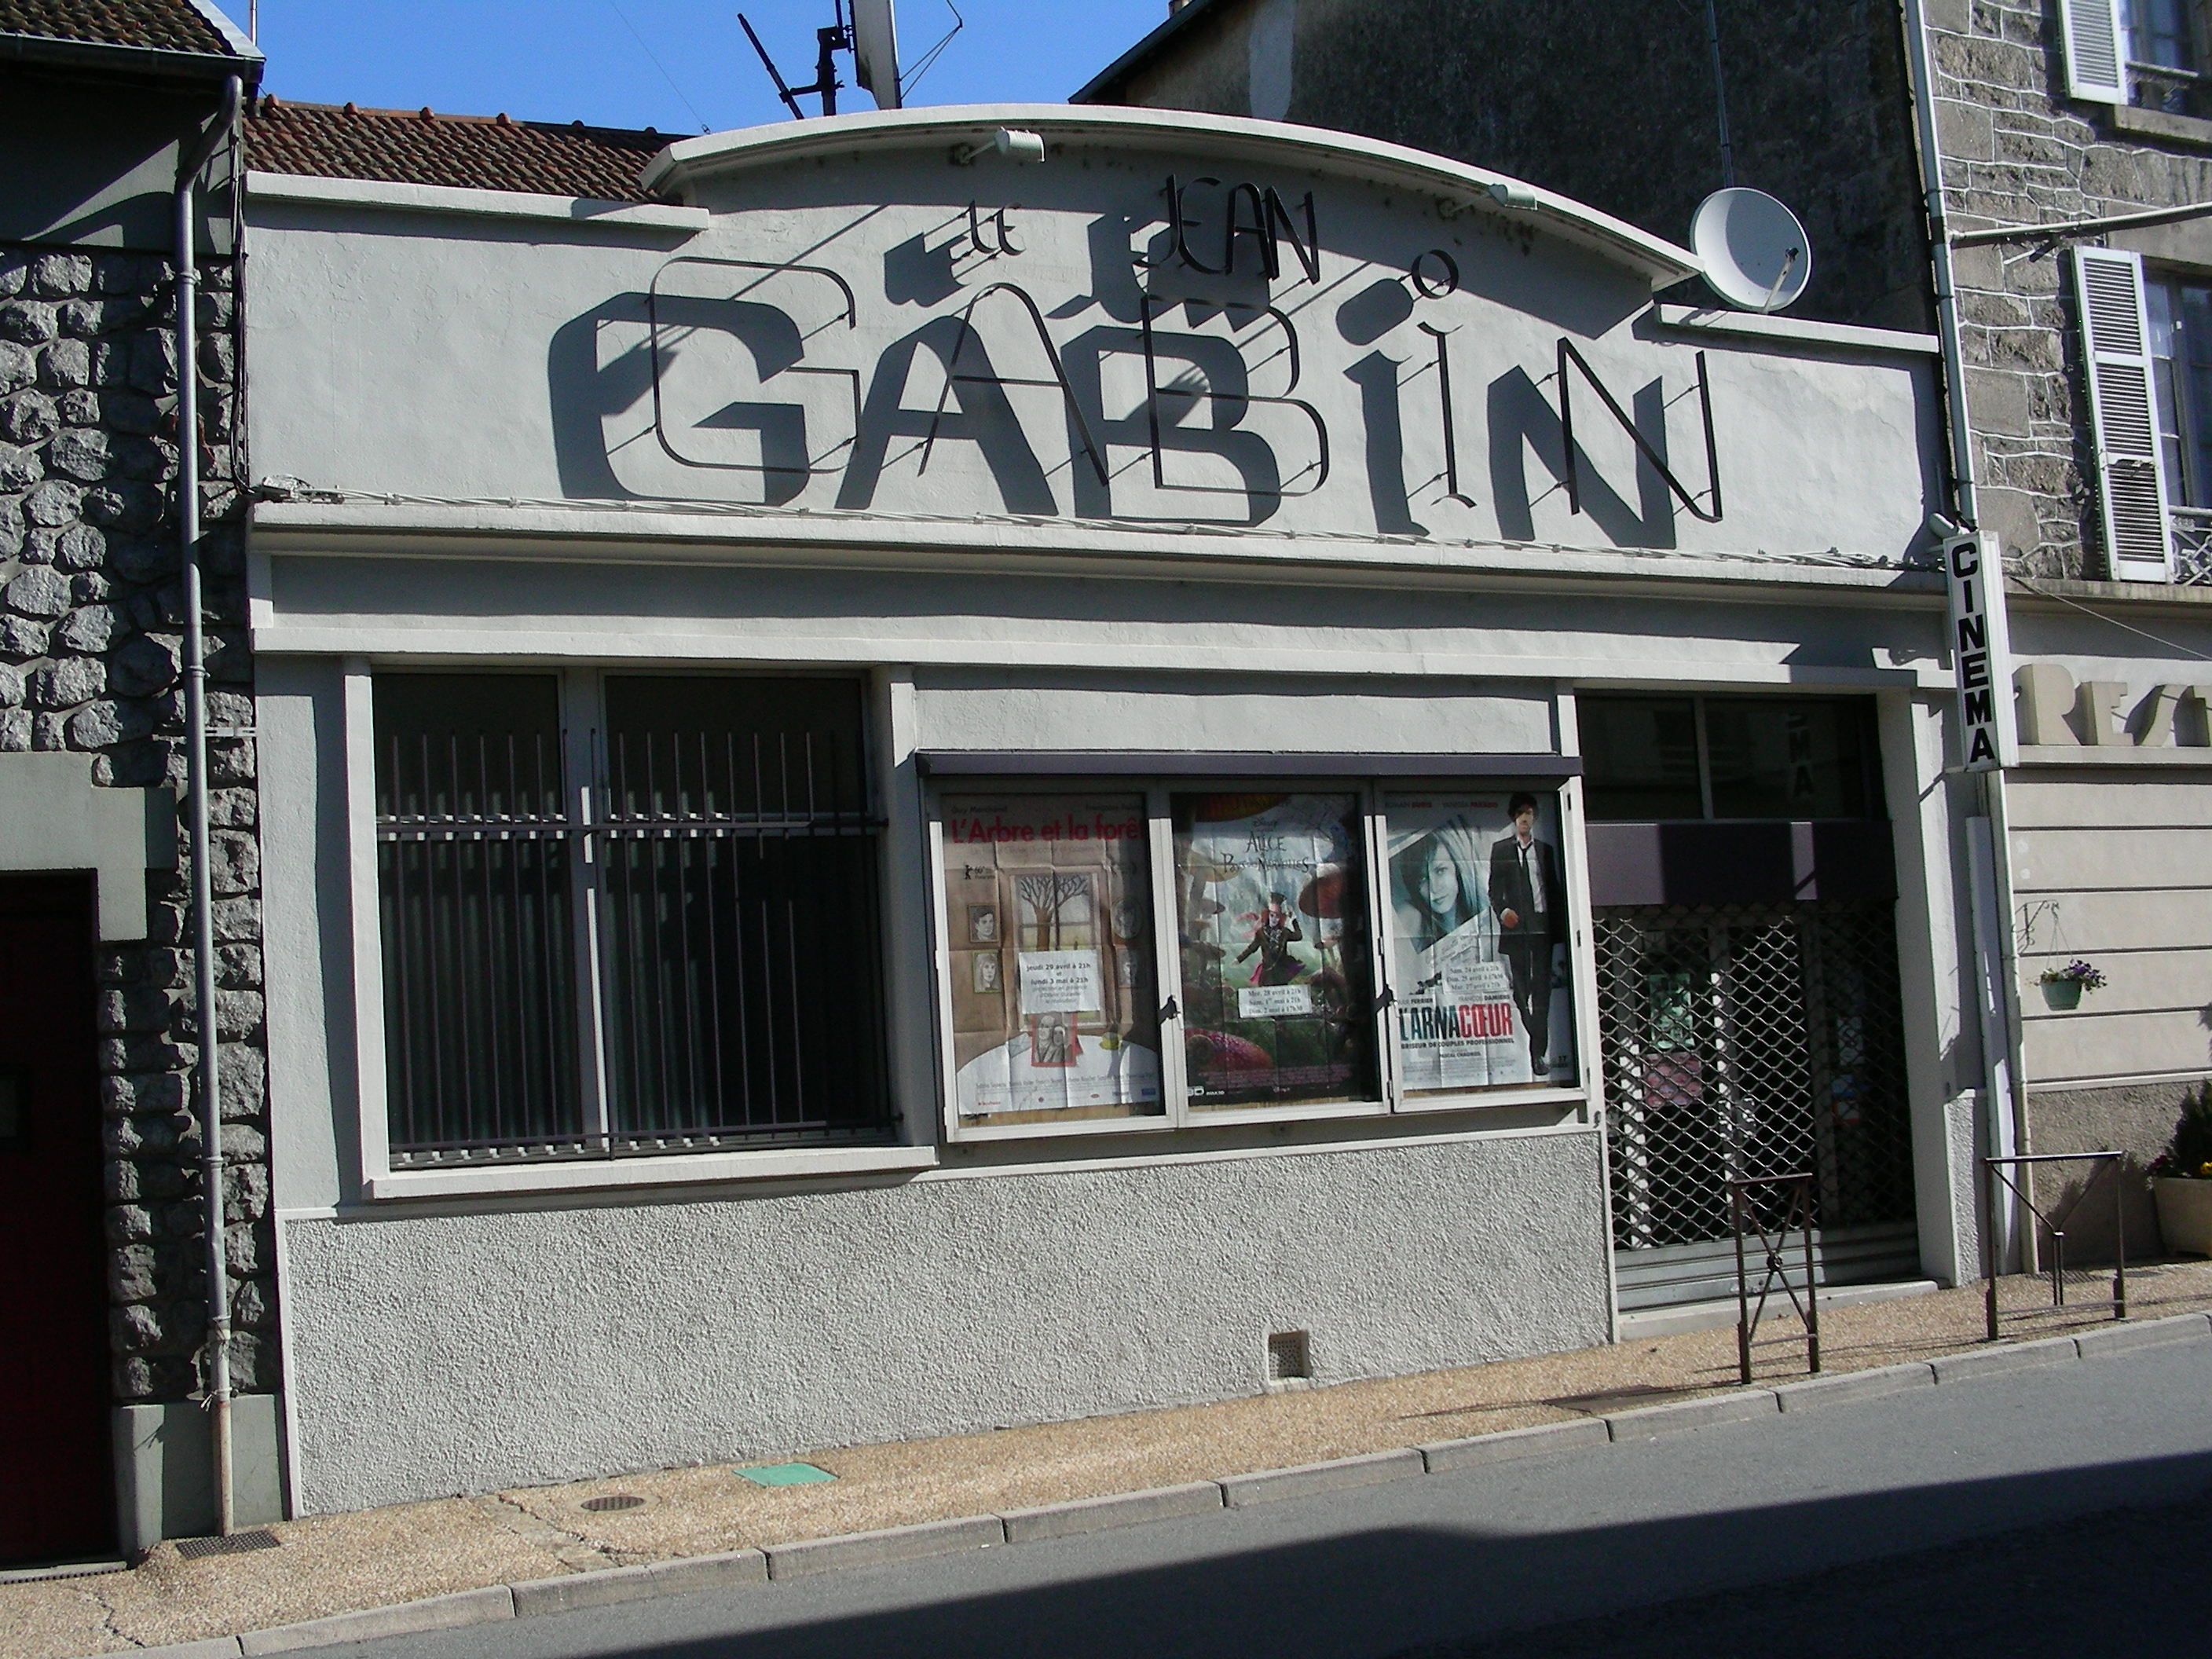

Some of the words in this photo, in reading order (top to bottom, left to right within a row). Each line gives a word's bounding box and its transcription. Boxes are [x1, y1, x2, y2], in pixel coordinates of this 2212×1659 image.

[1132, 173, 1320, 284] JEAN
[1951, 541, 1996, 763] CINEMA
[951, 815, 1035, 844] L'Arbre
[1040, 819, 1063, 841] et
[1068, 813, 1088, 840] la
